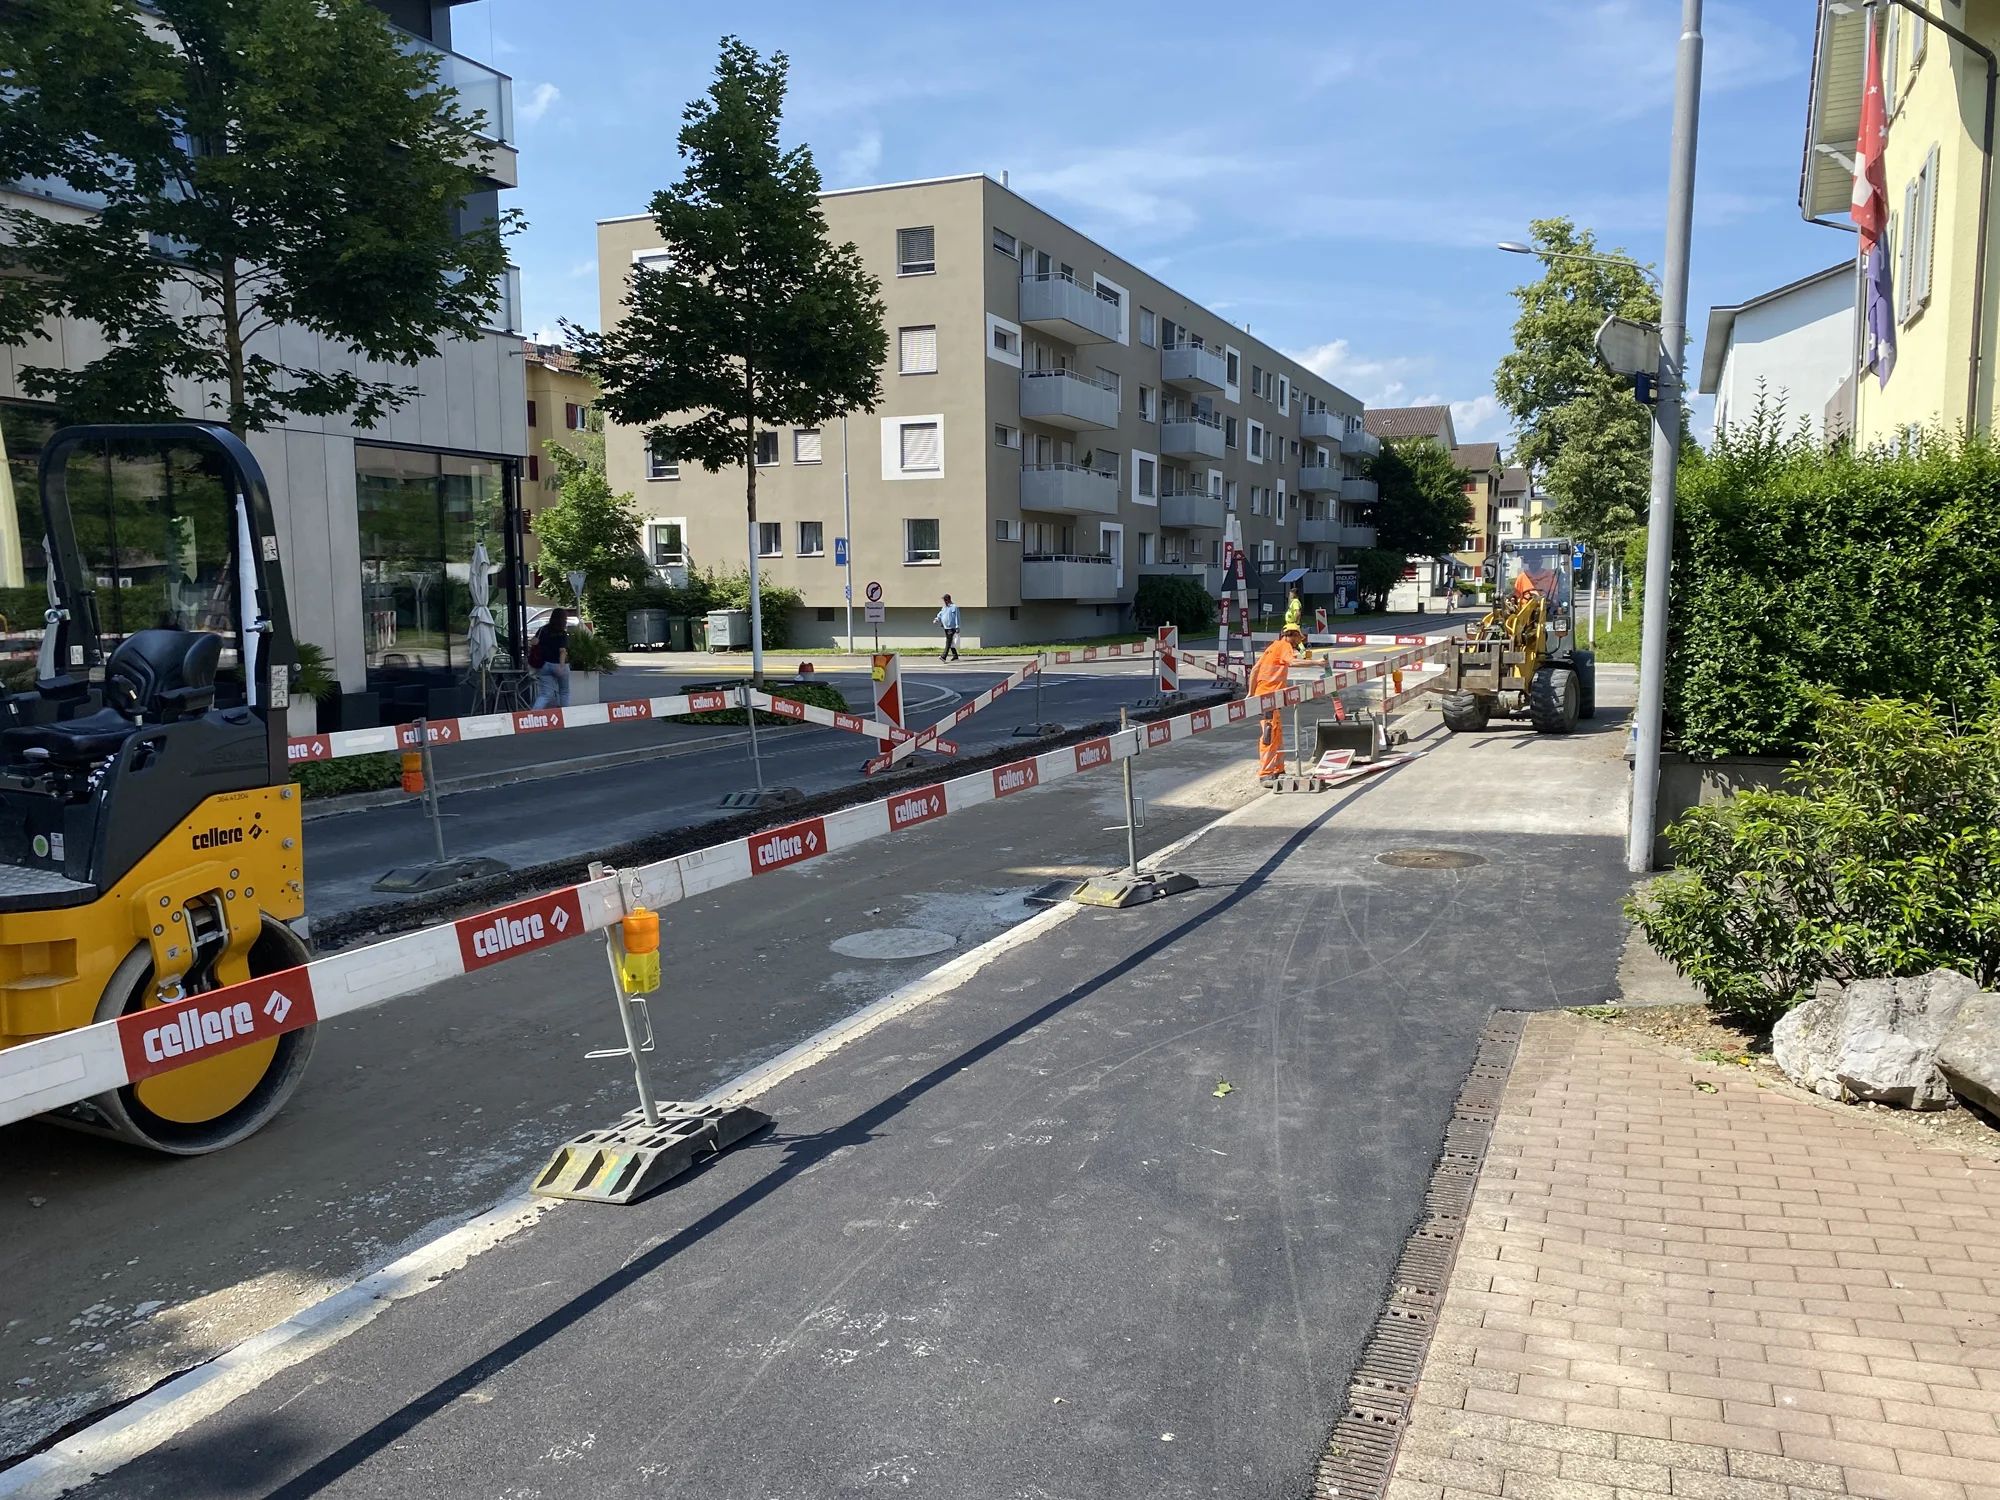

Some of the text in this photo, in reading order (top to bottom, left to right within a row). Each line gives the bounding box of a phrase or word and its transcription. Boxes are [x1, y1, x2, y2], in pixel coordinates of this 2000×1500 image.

[612, 704, 638, 718] cellere
[692, 696, 715, 709] cellere
[518, 713, 548, 729] cellere
[1079, 747, 1100, 767] cellere
[999, 769, 1025, 792] cellere
[895, 798, 928, 824] cellere
[192, 827, 243, 851] cellere
[757, 835, 803, 866] cellere
[473, 913, 545, 958] cellere
[143, 1001, 255, 1063] cellere
